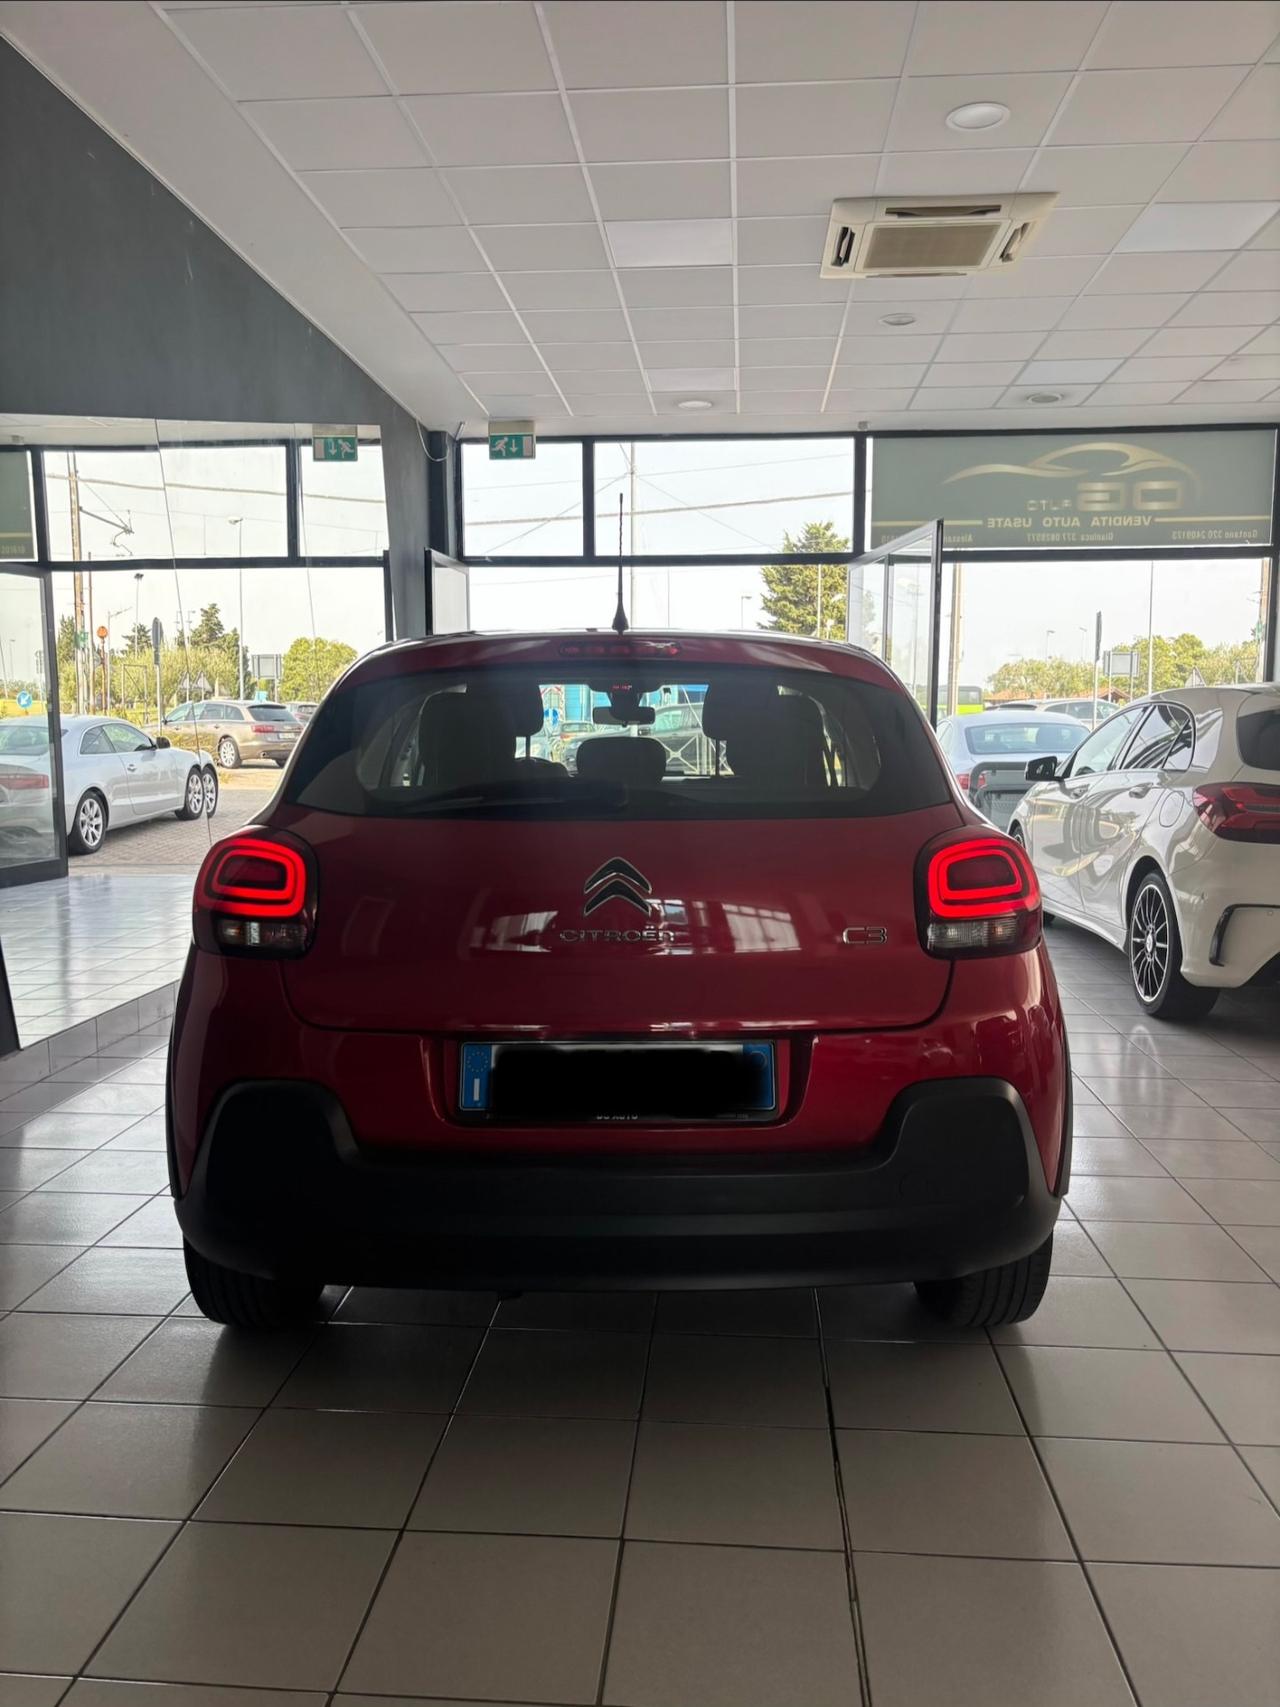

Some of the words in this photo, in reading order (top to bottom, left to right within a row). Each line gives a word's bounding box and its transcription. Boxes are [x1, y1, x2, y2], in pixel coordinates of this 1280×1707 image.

[560, 925, 675, 941] CITROËN
[842, 926, 888, 944] C3
[473, 1078, 480, 1101] I
